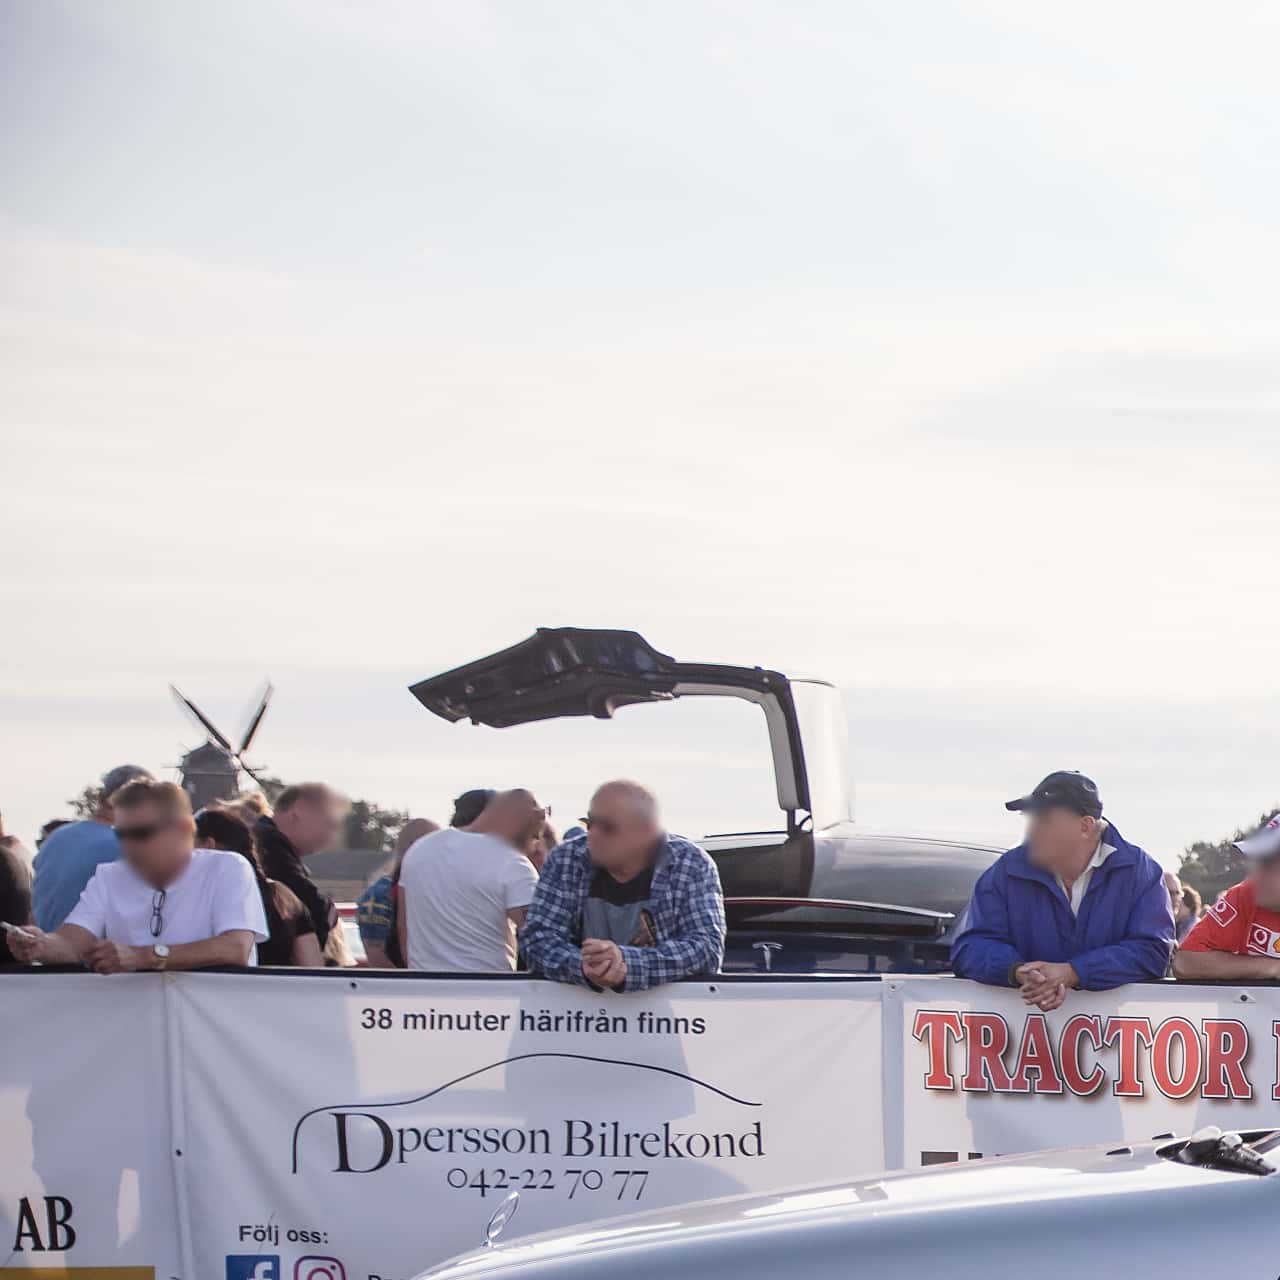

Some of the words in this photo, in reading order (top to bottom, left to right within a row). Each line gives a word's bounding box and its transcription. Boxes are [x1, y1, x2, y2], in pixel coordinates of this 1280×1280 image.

[361, 1008, 393, 1030] 38
[402, 1009, 511, 1031] minuter
[519, 1008, 628, 1033] härifrån
[637, 1012, 706, 1034] finns
[912, 1009, 1253, 1100] TRACTOR
[328, 1112, 552, 1174] Dpersson
[563, 1119, 766, 1159] Bilrekond
[447, 1168, 555, 1198] 042-22
[564, 1169, 603, 1200] 70
[612, 1170, 649, 1201] 77
[12, 1195, 77, 1252] AB
[239, 1225, 280, 1246] Följ
[286, 1229, 329, 1245] oss:
